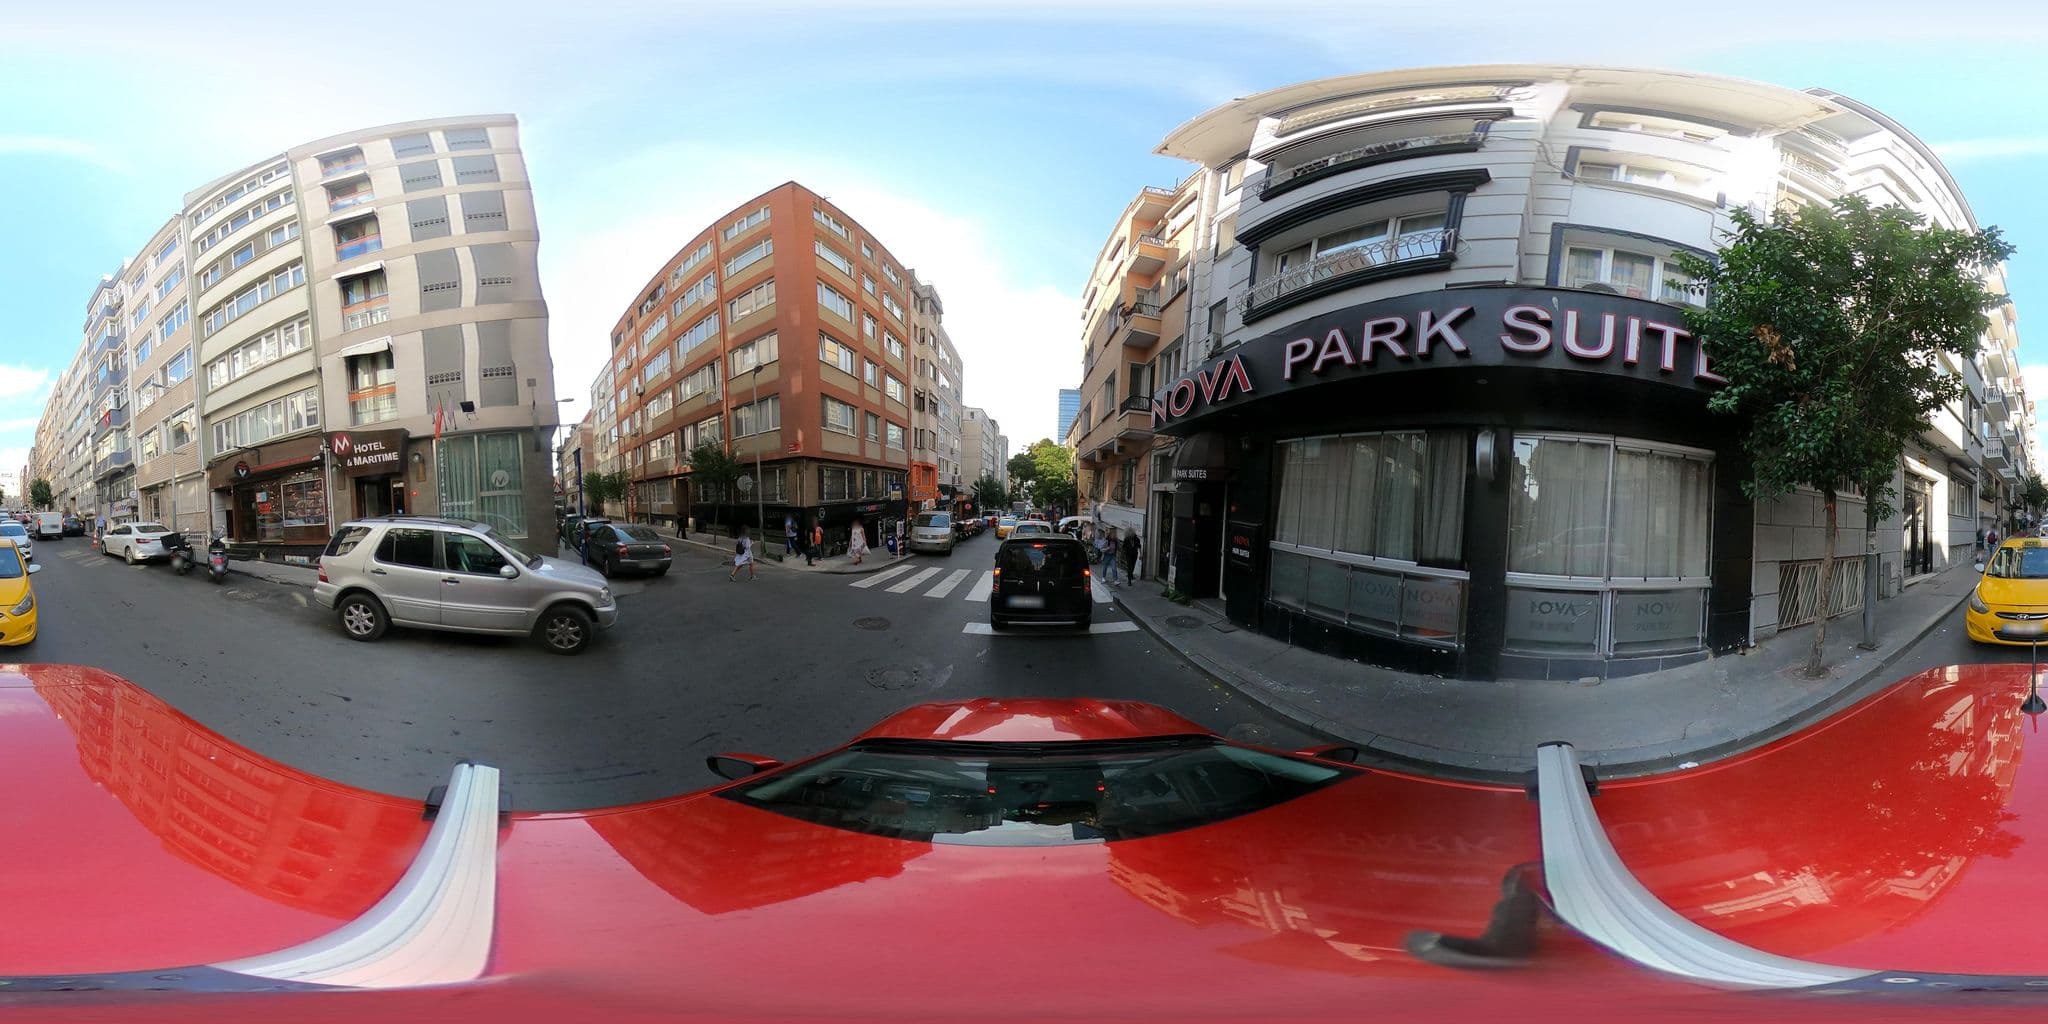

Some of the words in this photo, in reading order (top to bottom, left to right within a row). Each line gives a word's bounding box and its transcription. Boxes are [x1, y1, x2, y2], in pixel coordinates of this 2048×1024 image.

[1151, 353, 1253, 428] NOVA
[1283, 304, 1475, 381] PARK
[354, 441, 386, 454] HOTEL
[353, 451, 400, 467] MARITIME
[1176, 469, 1188, 479] PARK
[1188, 469, 1207, 479] SUITES
[1407, 588, 1455, 607] NOVA
